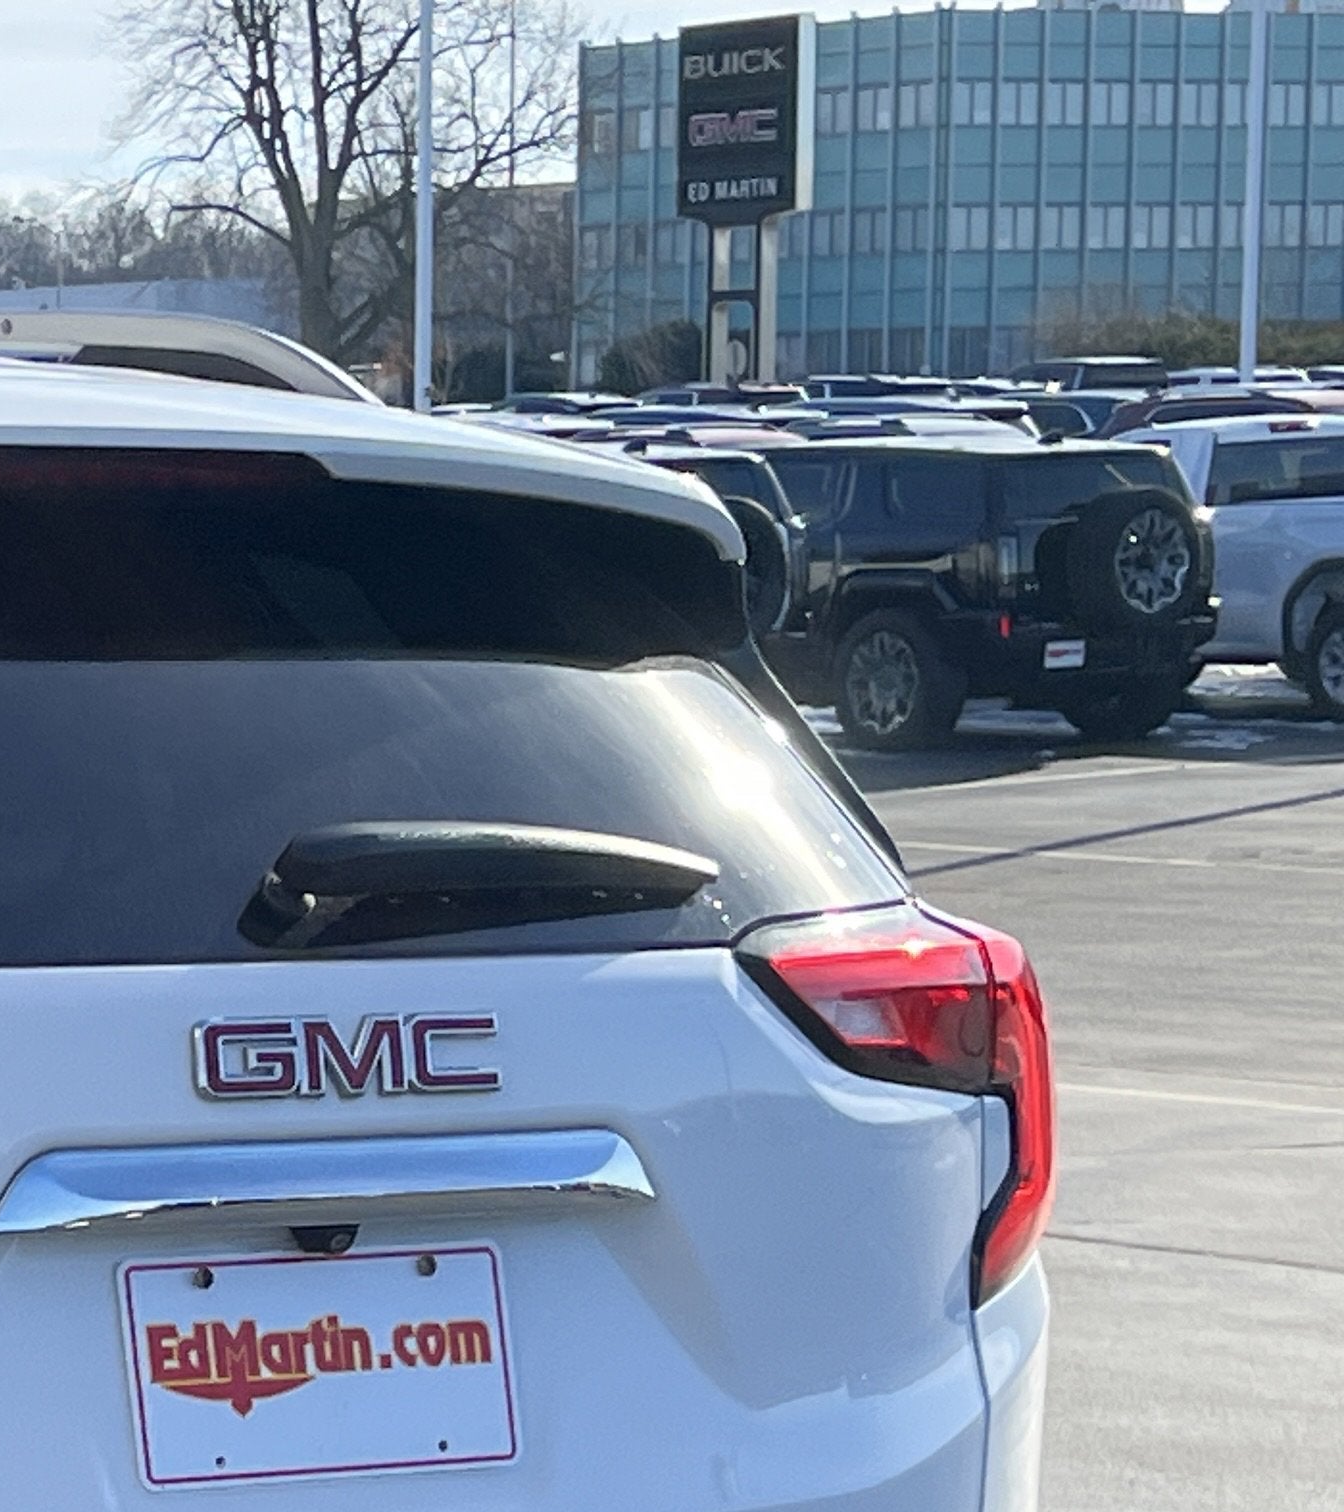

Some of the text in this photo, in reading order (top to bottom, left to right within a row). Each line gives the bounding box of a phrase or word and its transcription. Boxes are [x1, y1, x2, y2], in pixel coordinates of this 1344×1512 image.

[683, 48, 786, 80] BUICK
[688, 108, 778, 147] GMC
[688, 178, 778, 203] ED MARTIN
[193, 1012, 502, 1099] GMC
[145, 1314, 493, 1384] EdMartin.com
